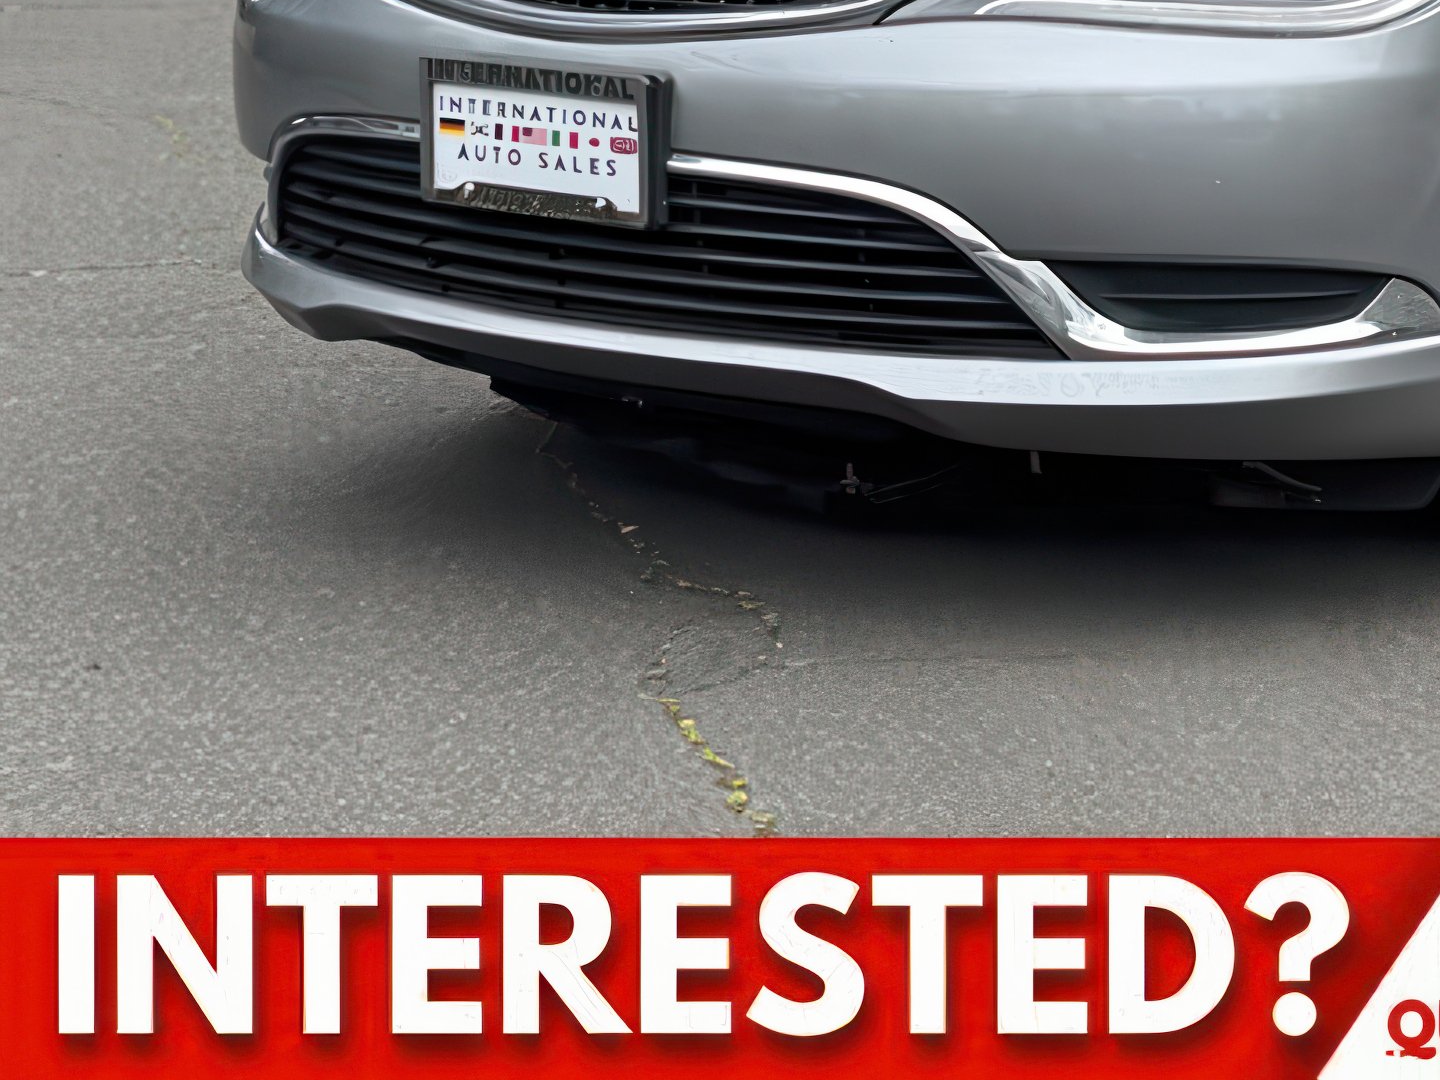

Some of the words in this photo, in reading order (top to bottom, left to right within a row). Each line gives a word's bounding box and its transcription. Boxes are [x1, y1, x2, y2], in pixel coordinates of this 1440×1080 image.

[438, 95, 639, 133] INTERNATIONAL
[457, 143, 522, 166] AUTO
[538, 151, 617, 177] SALES
